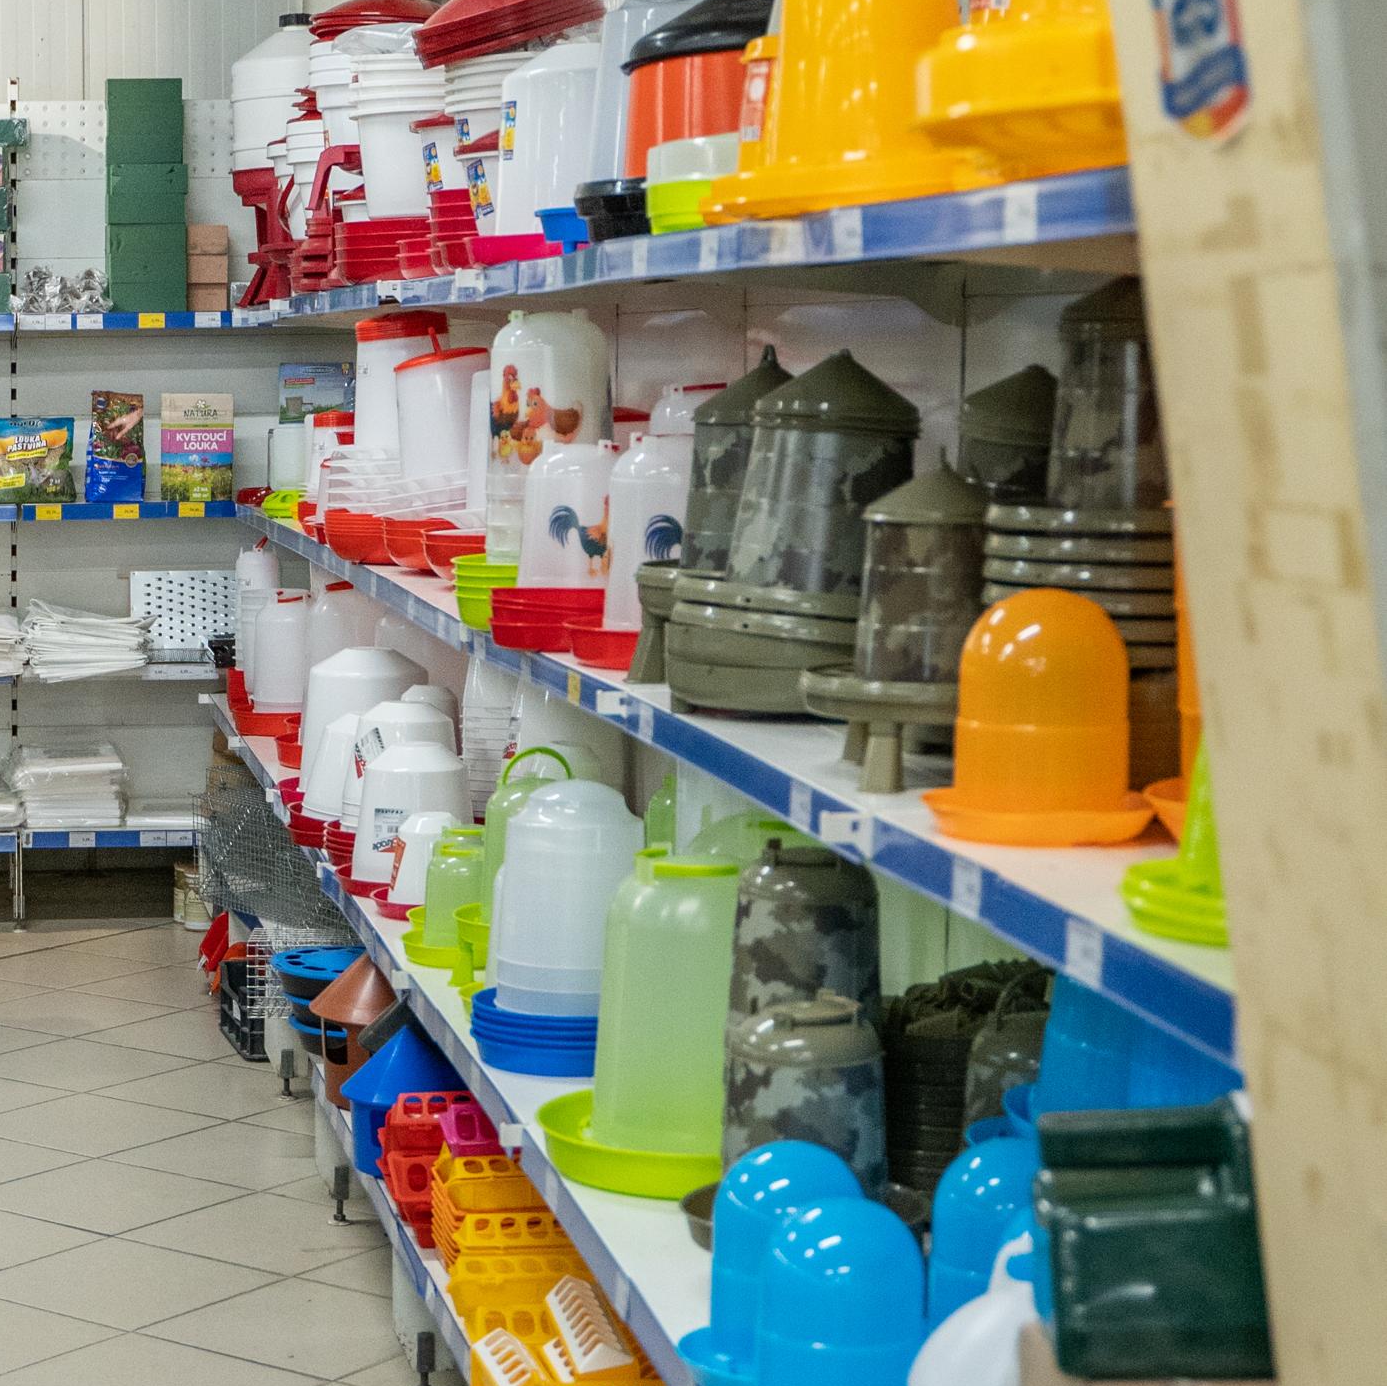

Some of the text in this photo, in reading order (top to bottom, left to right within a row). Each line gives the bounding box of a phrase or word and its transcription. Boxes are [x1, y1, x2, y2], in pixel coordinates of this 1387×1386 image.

[14, 435, 41, 444] LOUKA
[176, 430, 227, 442] KVETOUCÍ
[184, 442, 218, 450] LOUKA
